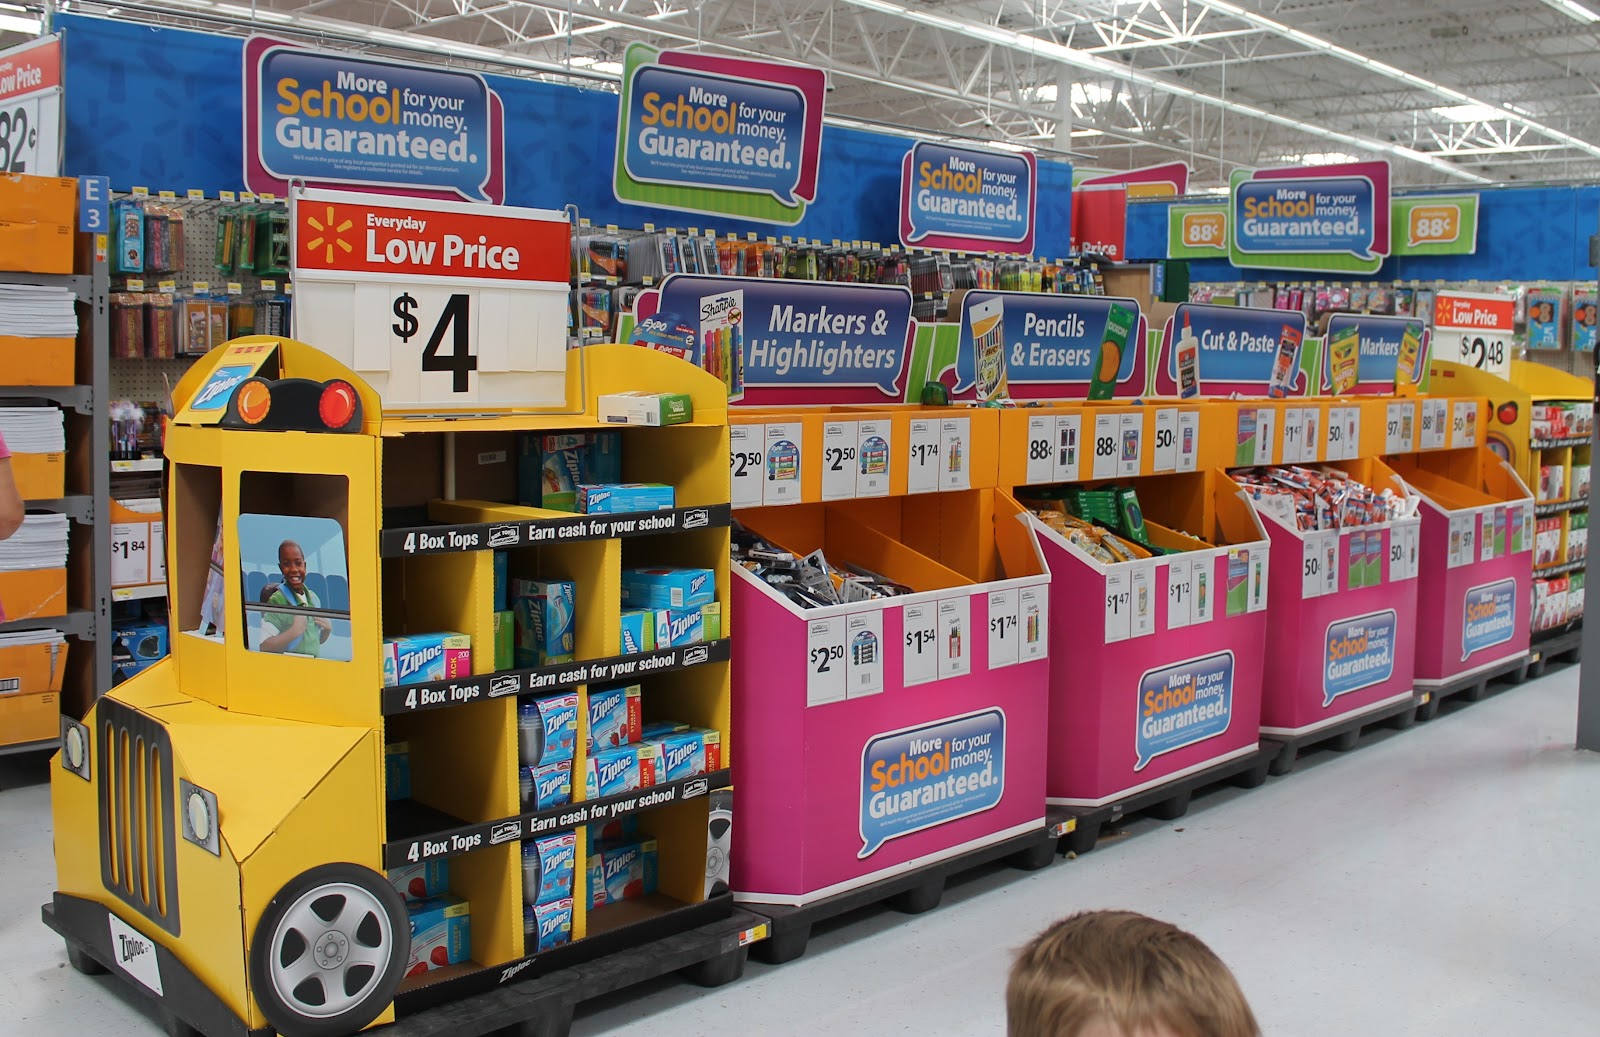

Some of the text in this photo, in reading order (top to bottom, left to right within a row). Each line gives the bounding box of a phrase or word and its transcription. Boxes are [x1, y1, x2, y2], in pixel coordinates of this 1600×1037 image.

[0, 75, 16, 94] ow
[16, 64, 42, 90] Price
[337, 71, 387, 94] More
[276, 77, 465, 125] School for your
[689, 86, 728, 107] More
[403, 109, 468, 135] money.
[641, 92, 786, 134] School for your
[275, 117, 478, 164] Guaranteed.
[737, 122, 787, 144] money.
[638, 127, 792, 170] Guaranteed.
[949, 156, 975, 172] More
[86, 179, 99, 200] E
[919, 161, 1016, 194] School for your
[982, 184, 1017, 200] money.
[1276, 189, 1307, 200] More
[88, 208, 100, 228] 3
[917, 189, 1022, 222] Guaranteed.
[1244, 193, 1357, 218] School for your
[1315, 206, 1359, 218] money.
[366, 213, 427, 234] Everyday
[1243, 215, 1366, 236] Guaranteed.
[366, 229, 520, 271] Low Price
[701, 297, 737, 321] Sharpie
[769, 304, 889, 337] Markers &
[1453, 308, 1498, 326] Low Price
[1024, 312, 1085, 338] Pencils
[1201, 329, 1275, 353] Cut & Paste
[1361, 337, 1399, 356] Markers
[749, 339, 896, 376] Highlighters
[1010, 342, 1026, 366] &
[1029, 342, 1091, 367] Erasers
[589, 491, 611, 506] Ziploc
[529, 514, 676, 541] Earn cash for your school
[404, 531, 479, 553] 4 Box Tops
[690, 574, 706, 593] Ziploc
[1467, 595, 1496, 622] School
[658, 609, 701, 641] 4 Ziploc
[1347, 627, 1364, 638] More
[458, 650, 469, 659] 200
[1329, 630, 1369, 661] School
[384, 657, 395, 675] 4
[400, 645, 442, 678] Ziploc
[529, 652, 676, 689] Earn cash for your school
[1327, 647, 1391, 680] Guaranteed.
[1169, 673, 1191, 688] More
[1195, 683, 1224, 700] money.
[405, 684, 480, 709] 4 Box Tops
[1143, 671, 1224, 717] School for your
[547, 708, 574, 735] Ziploc
[592, 693, 620, 725] Ziploc
[1142, 694, 1228, 739] Guaranteed.
[655, 740, 698, 772] 4 Ziploc
[909, 738, 942, 756] More
[951, 747, 993, 770] money.
[587, 755, 632, 788] 4 Ziploc
[870, 732, 992, 792] School for your
[540, 773, 567, 799] Ziploc
[869, 761, 999, 819] Guaranteed.
[530, 787, 676, 833] Earn cash for your school
[407, 833, 482, 862] 4 Box Tops
[544, 848, 572, 875] Ziploc
[606, 850, 636, 879] Ziploc
[541, 912, 568, 938] Ziploc
[119, 934, 144, 963] Ziploc
[500, 959, 532, 984] Ziploc
